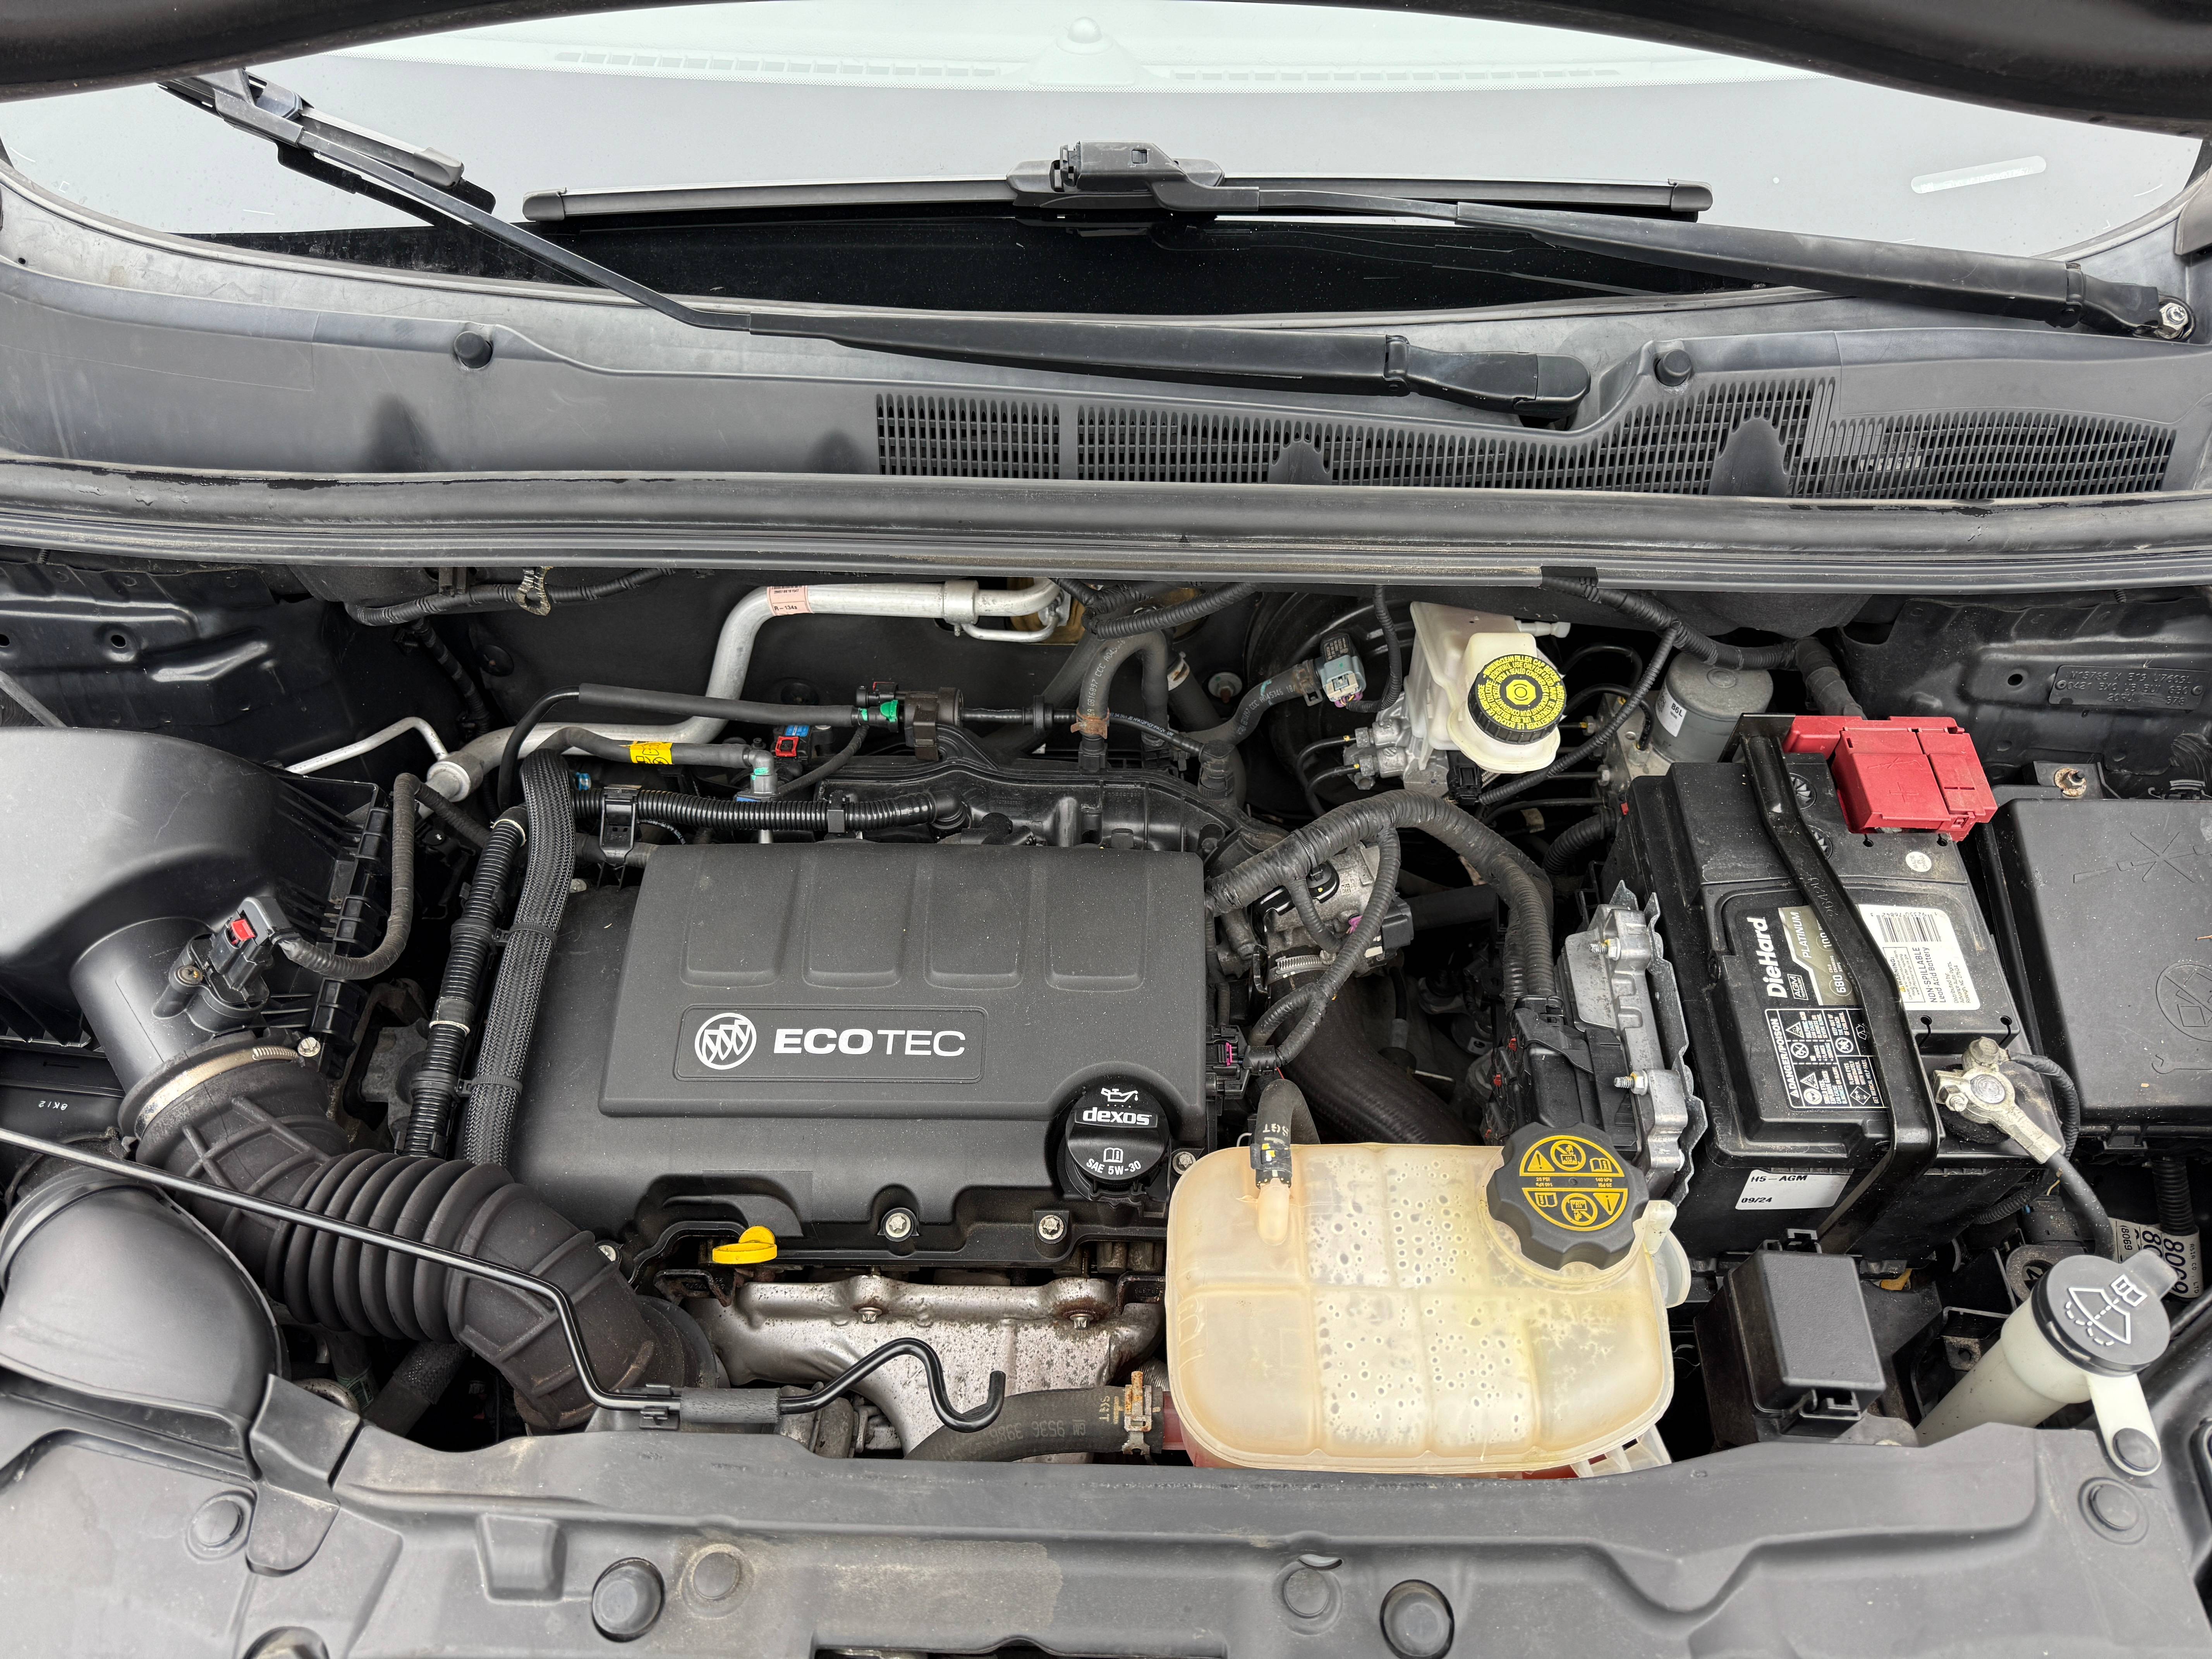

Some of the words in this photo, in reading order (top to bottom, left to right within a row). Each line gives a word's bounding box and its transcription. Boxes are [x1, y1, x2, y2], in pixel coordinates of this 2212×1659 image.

[1095, 663, 1105, 677] CCC
[1515, 655, 1532, 663] FILLER
[1533, 659, 1545, 667] CAP
[1543, 665, 1560, 682] BEFORE
[1523, 662, 1536, 670] ONLY
[1496, 672, 1507, 684] FROM
[1486, 708, 1495, 716] DE
[1495, 699, 1520, 716] CONTENANT
[1671, 703, 1683, 717] B6L
[1493, 714, 1515, 728] BOUCHON
[1910, 855, 1918, 869] MADE
[1919, 855, 1928, 869] CHINA
[1790, 912, 1812, 958] PLATINUM
[1748, 918, 1787, 997] DieHard
[1830, 955, 1838, 973] CRANKING
[1922, 947, 1935, 971] Battery
[1890, 957, 1903, 985] WARNING:
[1912, 948, 1937, 1003] NON-SPILLABLE
[1930, 972, 1940, 986] Acid
[1790, 976, 1802, 998] AGM
[1832, 975, 1846, 993] 680
[1946, 980, 1959, 1003] Distributed
[1935, 988, 1946, 1003] Lead
[1955, 986, 1965, 1003] Advance
[774, 1028, 966, 1056] ECOTEC
[1771, 1019, 1796, 1089] DANGER/POISON
[1819, 1045, 1827, 1058] FLAMES
[1822, 1071, 1830, 1083] GASES
[1849, 1061, 1860, 1085] IMMEDIATELY
[1826, 1084, 1836, 1104] EXPLOSIVE
[1868, 1080, 1876, 1096] MEDICAL
[1083, 1107, 1152, 1125] dexos
[1086, 1158, 1105, 1173] SAE
[1108, 1160, 1141, 1175] 5W-30
[1031, 1420, 1065, 1438] 9536
